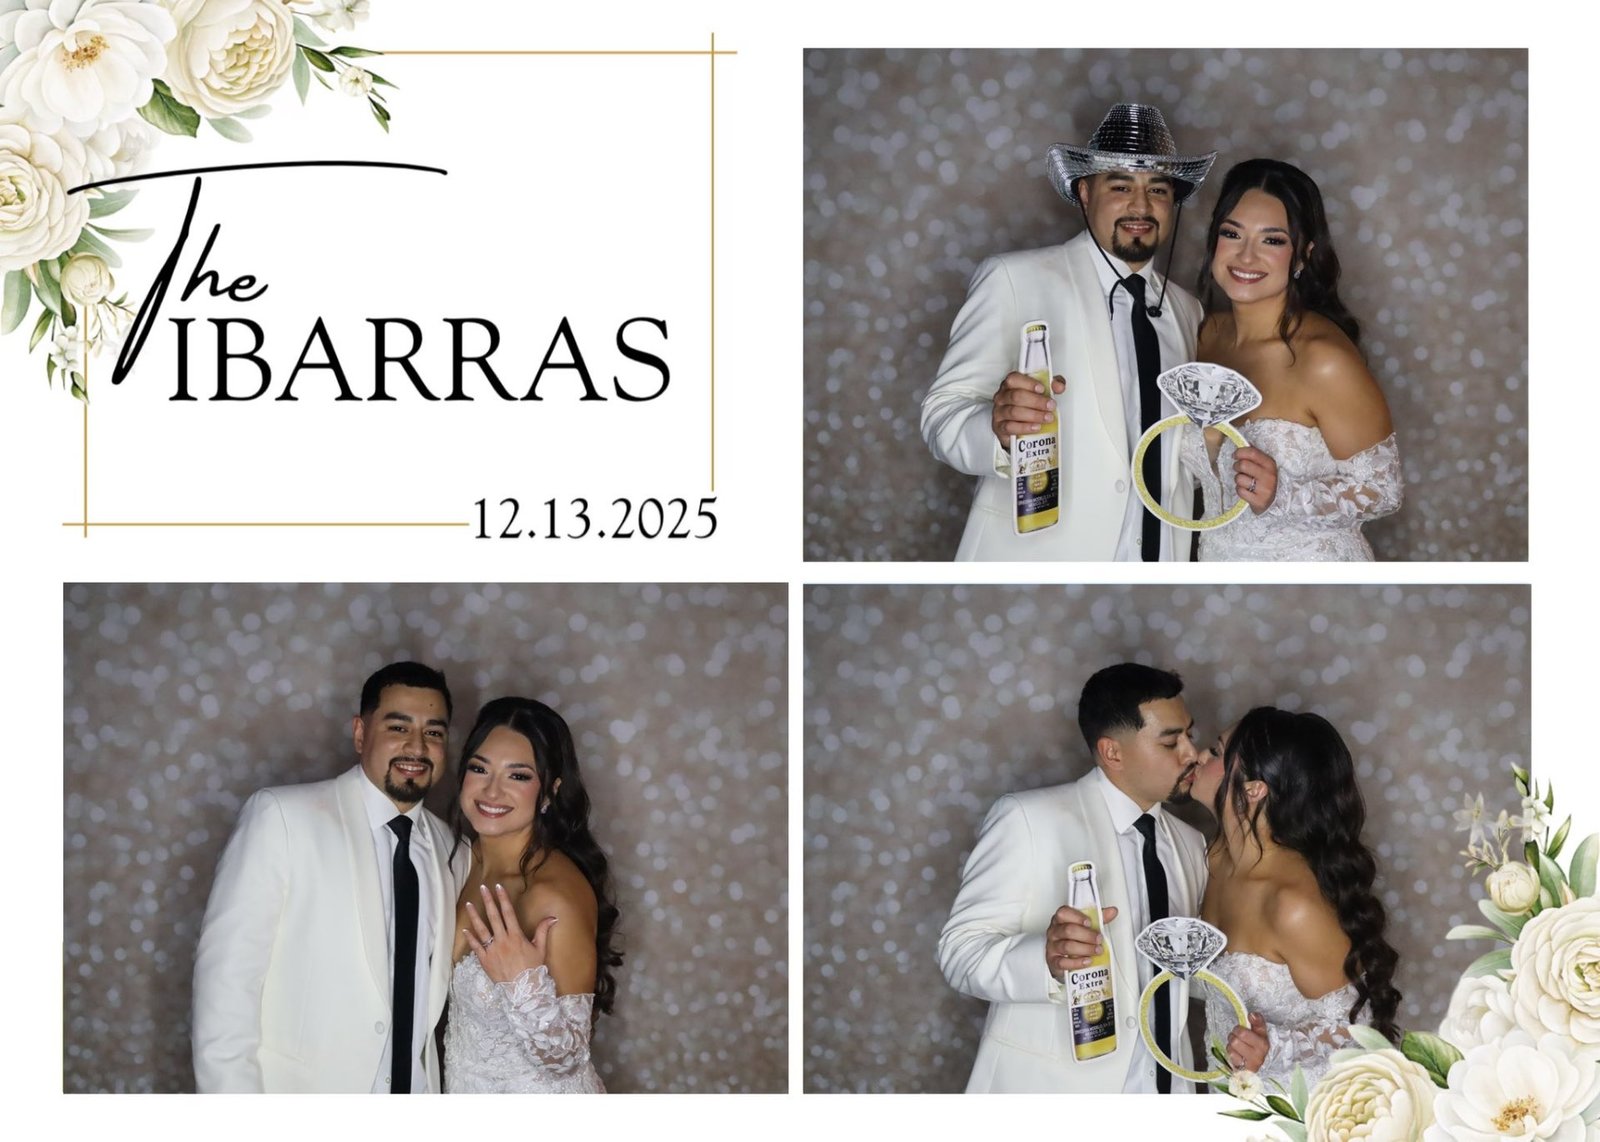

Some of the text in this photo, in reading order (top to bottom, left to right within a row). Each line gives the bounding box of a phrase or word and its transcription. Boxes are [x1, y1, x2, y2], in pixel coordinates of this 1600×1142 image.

[1018, 436, 1056, 453] Corona
[1026, 448, 1050, 458] Extra
[1071, 968, 1109, 985] Corona
[1079, 980, 1103, 990] Extra
